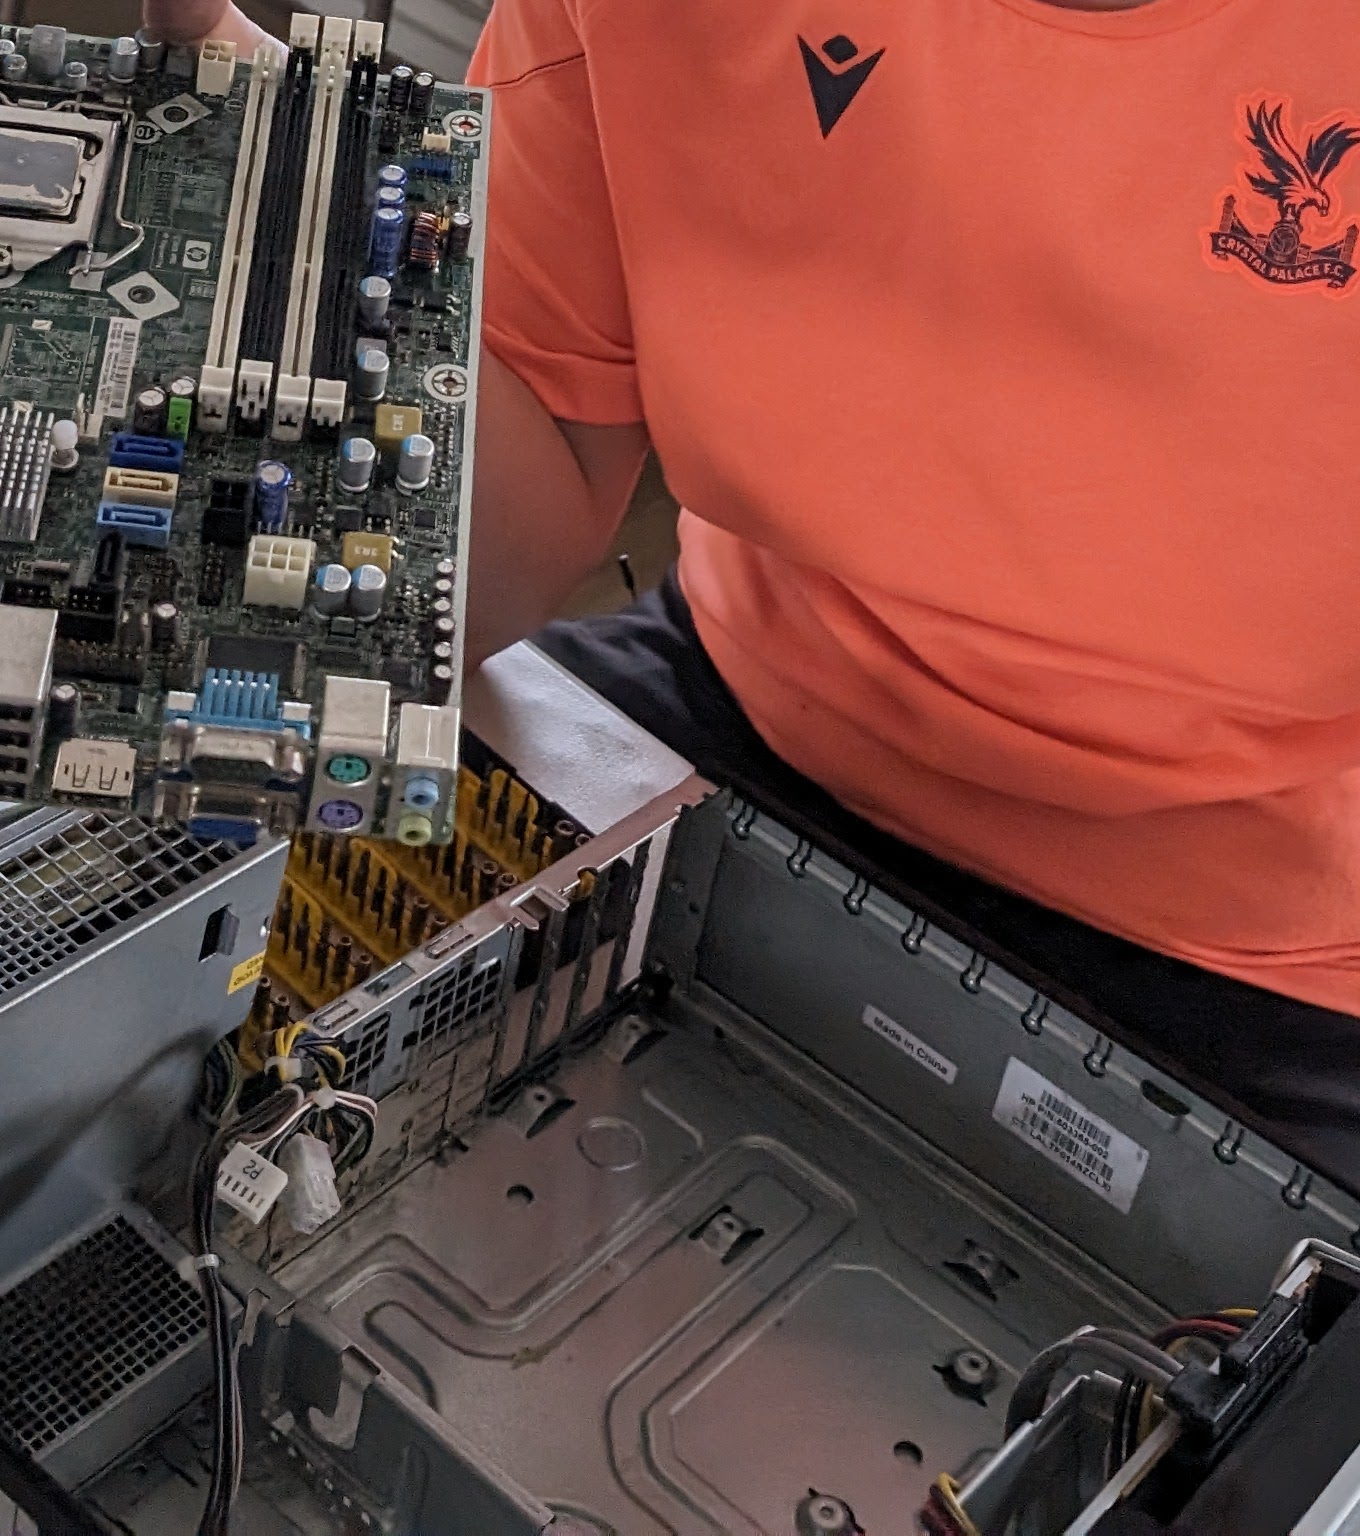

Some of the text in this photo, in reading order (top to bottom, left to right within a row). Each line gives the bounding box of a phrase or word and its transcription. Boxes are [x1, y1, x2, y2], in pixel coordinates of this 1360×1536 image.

[1217, 235, 1344, 281] CRYSTAL PALACE F.C.
[874, 1016, 947, 1075] Made in China
[242, 1159, 265, 1180] P2
